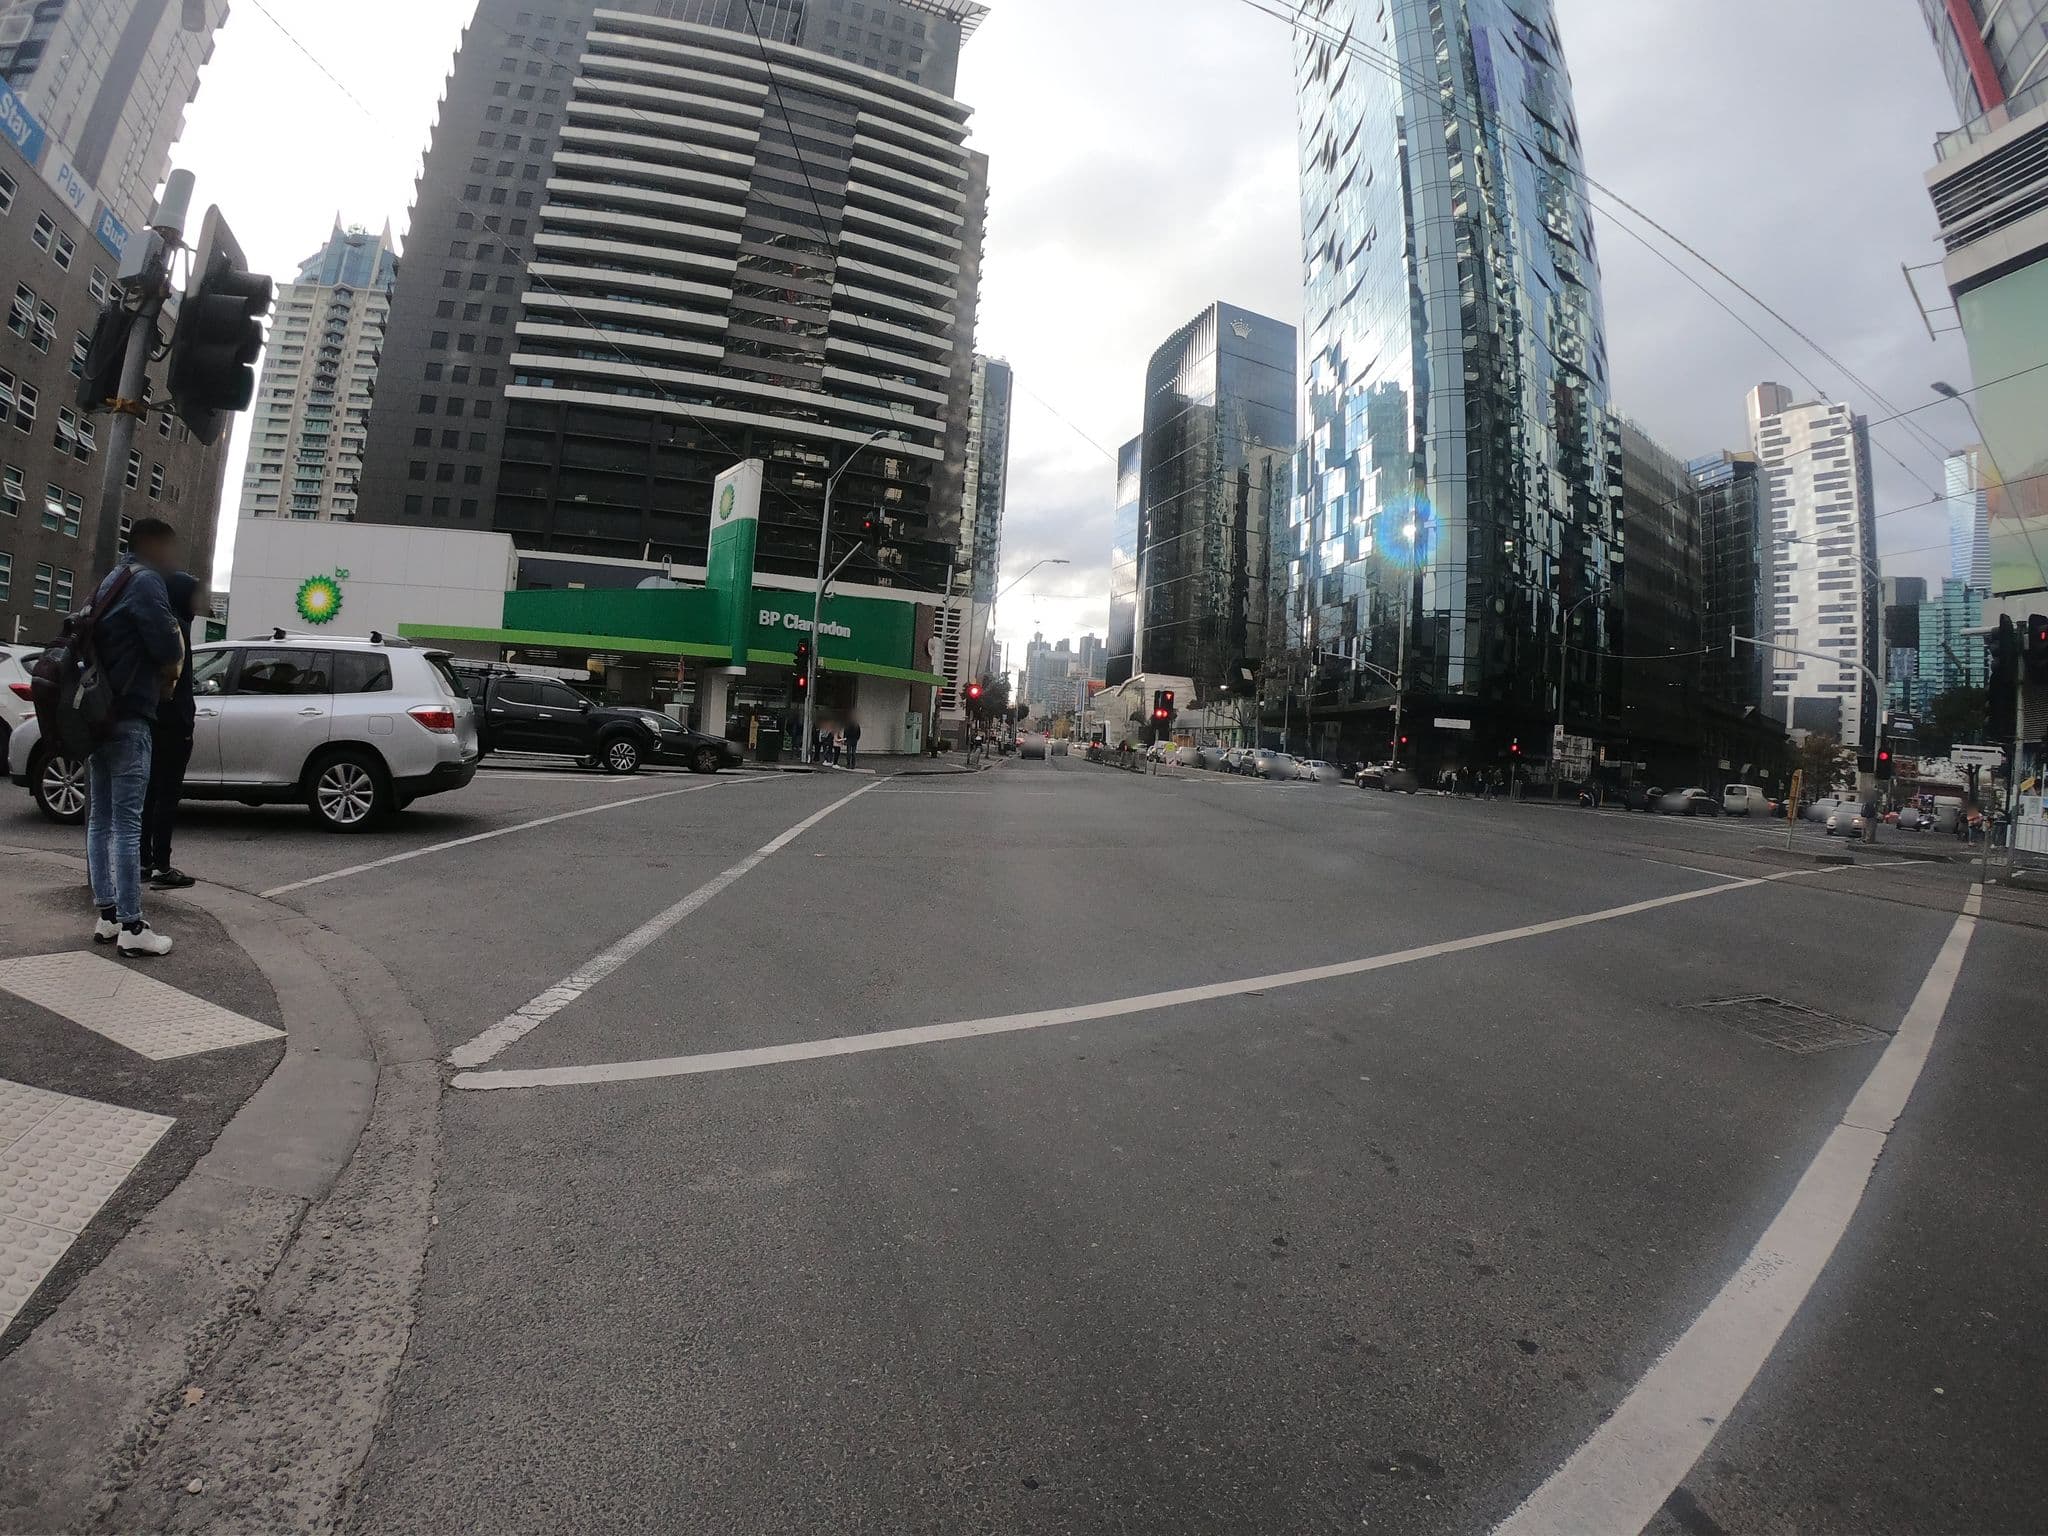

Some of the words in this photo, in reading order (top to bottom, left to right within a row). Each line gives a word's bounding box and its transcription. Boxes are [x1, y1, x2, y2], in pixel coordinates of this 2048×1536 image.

[0, 93, 32, 146] Stay
[57, 161, 86, 208] Play
[102, 214, 128, 257] Bud
[335, 564, 350, 581] bp
[759, 609, 780, 626] BP
[783, 613, 851, 638] Clarndon
